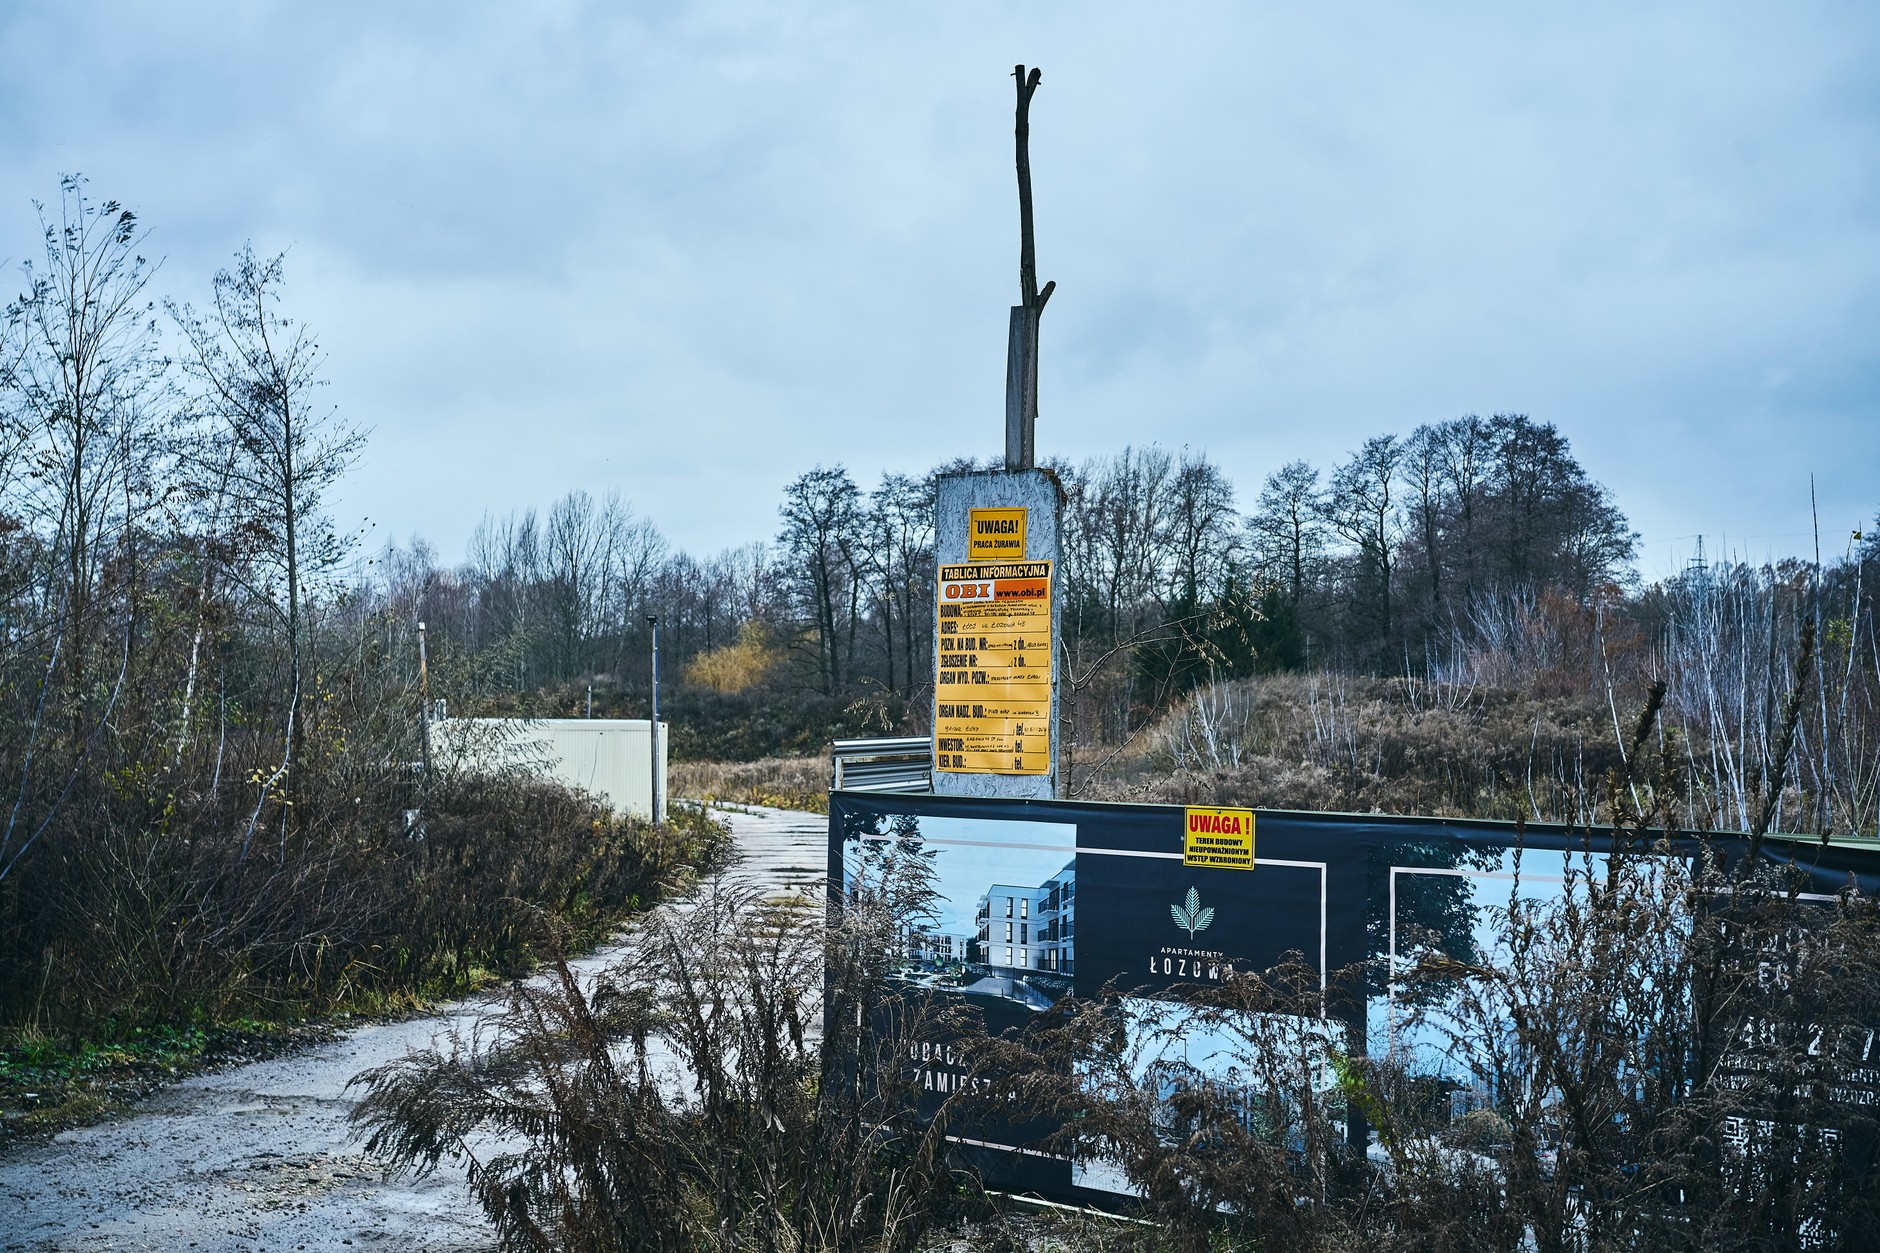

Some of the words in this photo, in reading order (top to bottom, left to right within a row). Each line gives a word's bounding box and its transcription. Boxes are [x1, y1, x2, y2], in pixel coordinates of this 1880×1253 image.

[977, 520, 1018, 534] UWAGA!
[974, 540, 992, 548] PRACA
[994, 538, 1020, 548] ŻURAWIA
[944, 568, 978, 580] TABLICA
[980, 565, 1046, 578] INFORMACYJNA
[946, 584, 990, 598] OBI
[996, 588, 1045, 598] www.obi.pl
[941, 621, 958, 634] ADRES:
[957, 638, 964, 650] NA
[966, 638, 977, 651] BUD.
[940, 671, 956, 684] ORGAN
[939, 704, 954, 718] ORGAN
[1016, 722, 1024, 736] tel.
[939, 738, 964, 752] INWESTOR:
[1015, 740, 1024, 753] tel.
[939, 755, 951, 768] KIER.
[1014, 757, 1024, 770] tel.
[1190, 814, 1242, 834] UWAGA
[1216, 838, 1243, 846] BUDOWY
[1190, 846, 1249, 856] NIEUPOWAŻNIONYM
[1187, 854, 1208, 863] WSTĘP
[1210, 856, 1250, 865] WZBRONIONY
[1160, 946, 1223, 958] APARTAMENTY
